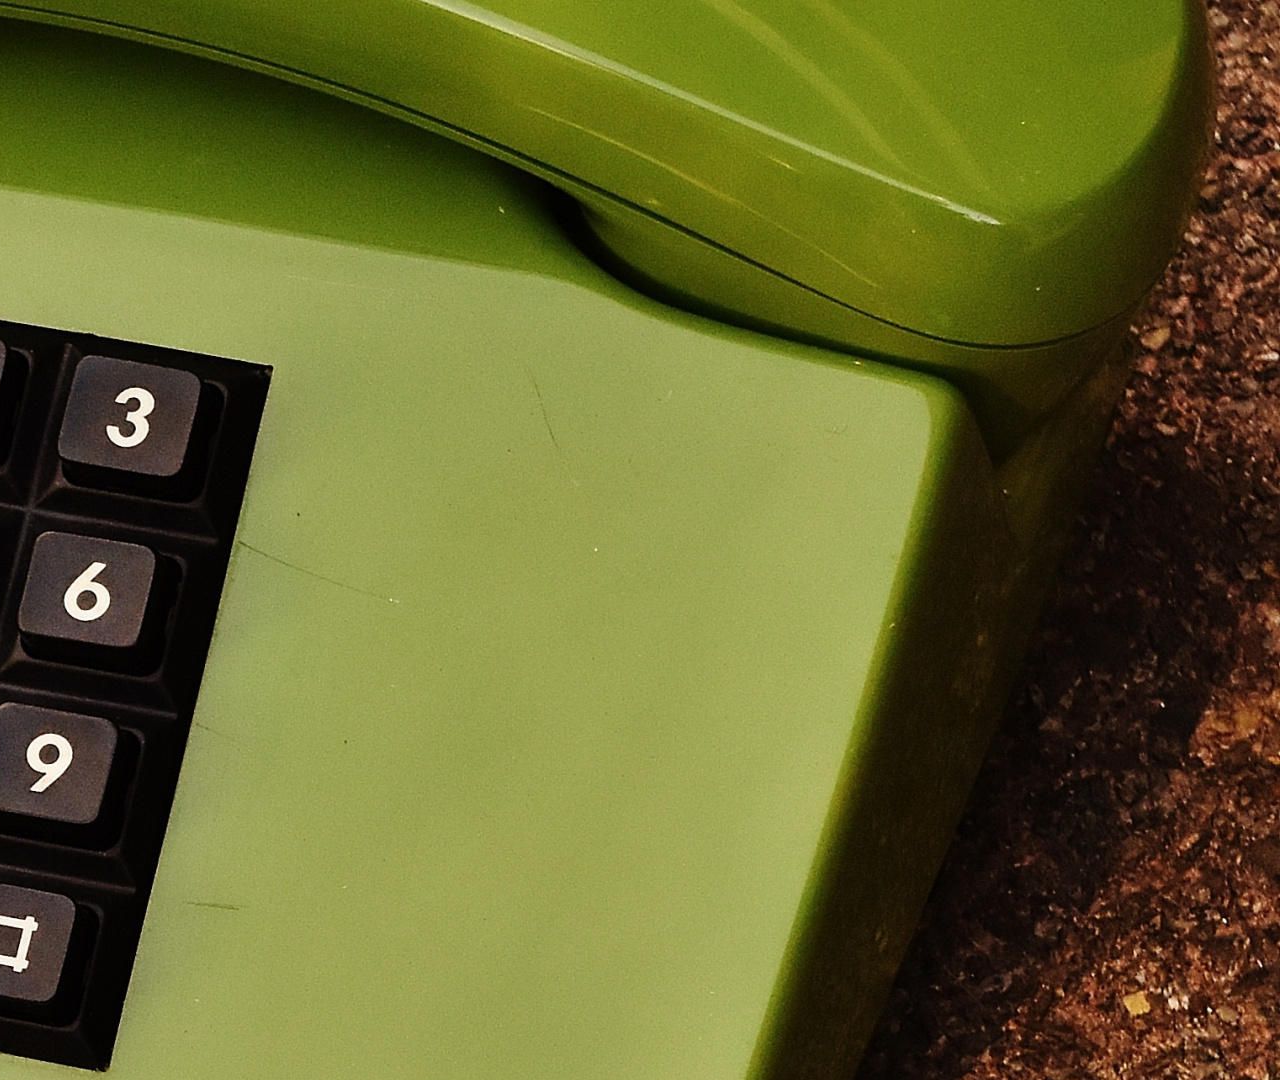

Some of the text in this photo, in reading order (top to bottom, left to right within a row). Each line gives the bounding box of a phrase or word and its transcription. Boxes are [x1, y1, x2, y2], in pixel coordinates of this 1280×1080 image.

[106, 387, 155, 448] 3
[63, 561, 111, 622] 6
[26, 732, 74, 793] 9
